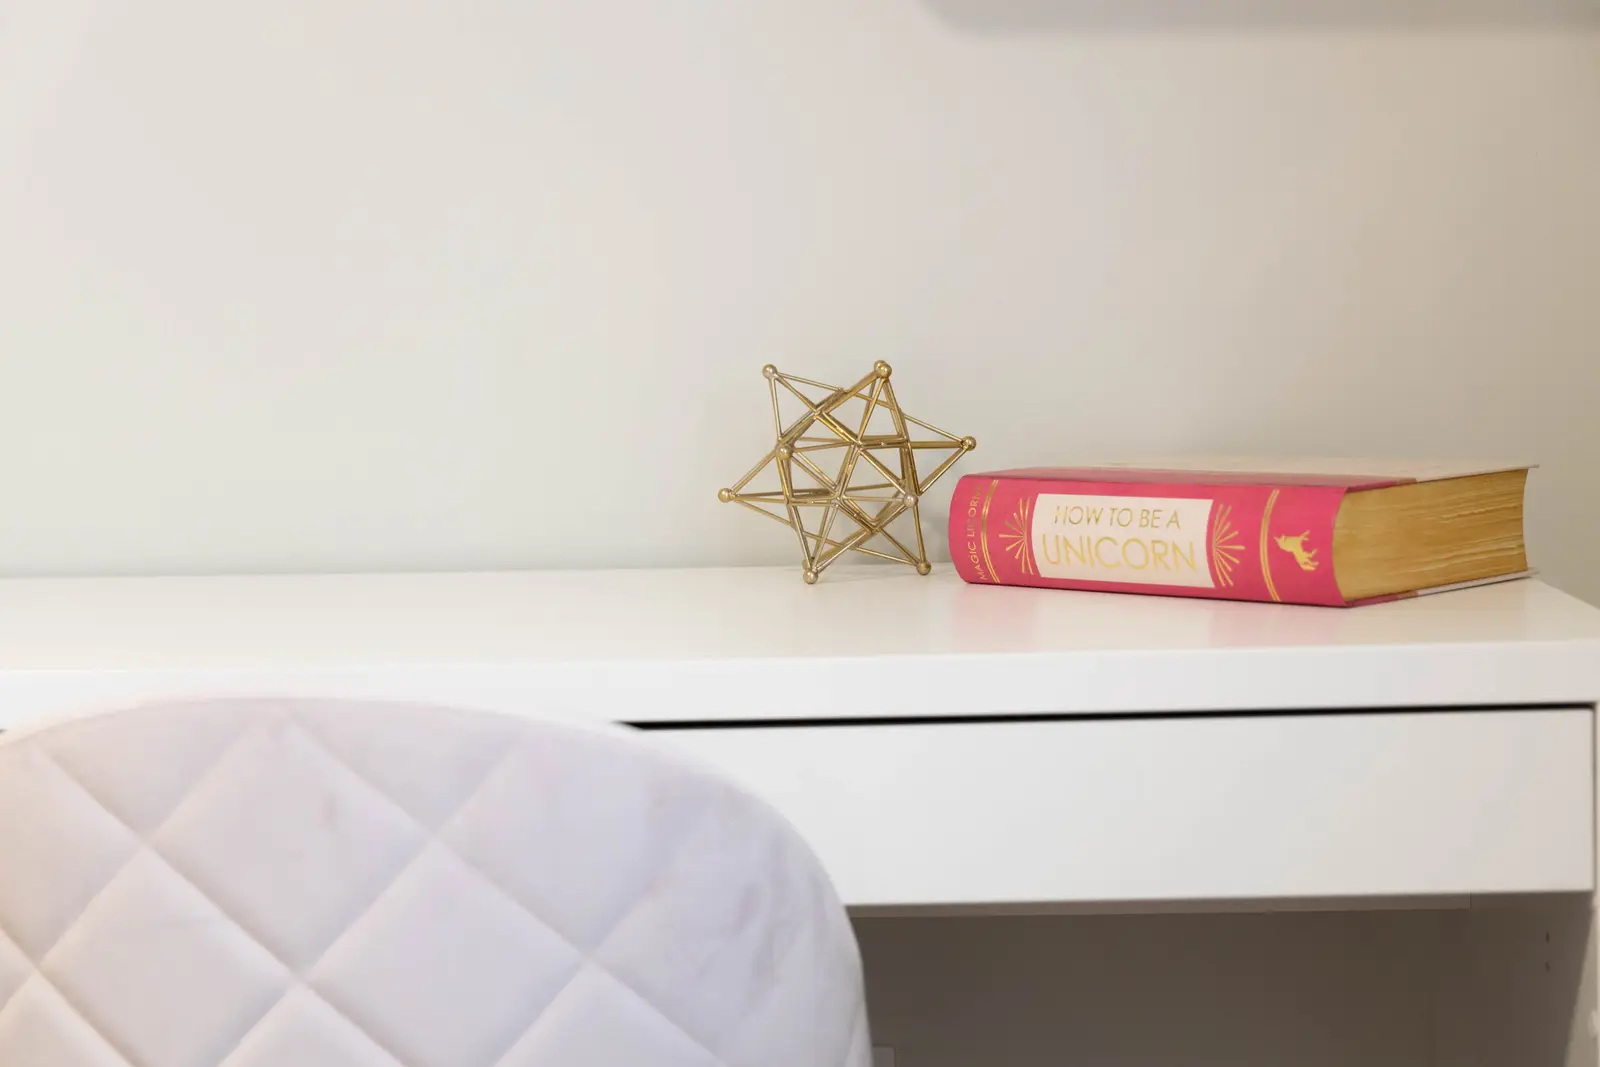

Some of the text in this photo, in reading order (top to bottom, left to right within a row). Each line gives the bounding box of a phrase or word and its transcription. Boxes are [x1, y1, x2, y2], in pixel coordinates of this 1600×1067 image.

[1054, 506, 1181, 529] HOW TO BE A
[967, 541, 987, 580] MAGIC
[1042, 534, 1196, 571] UNICORN
